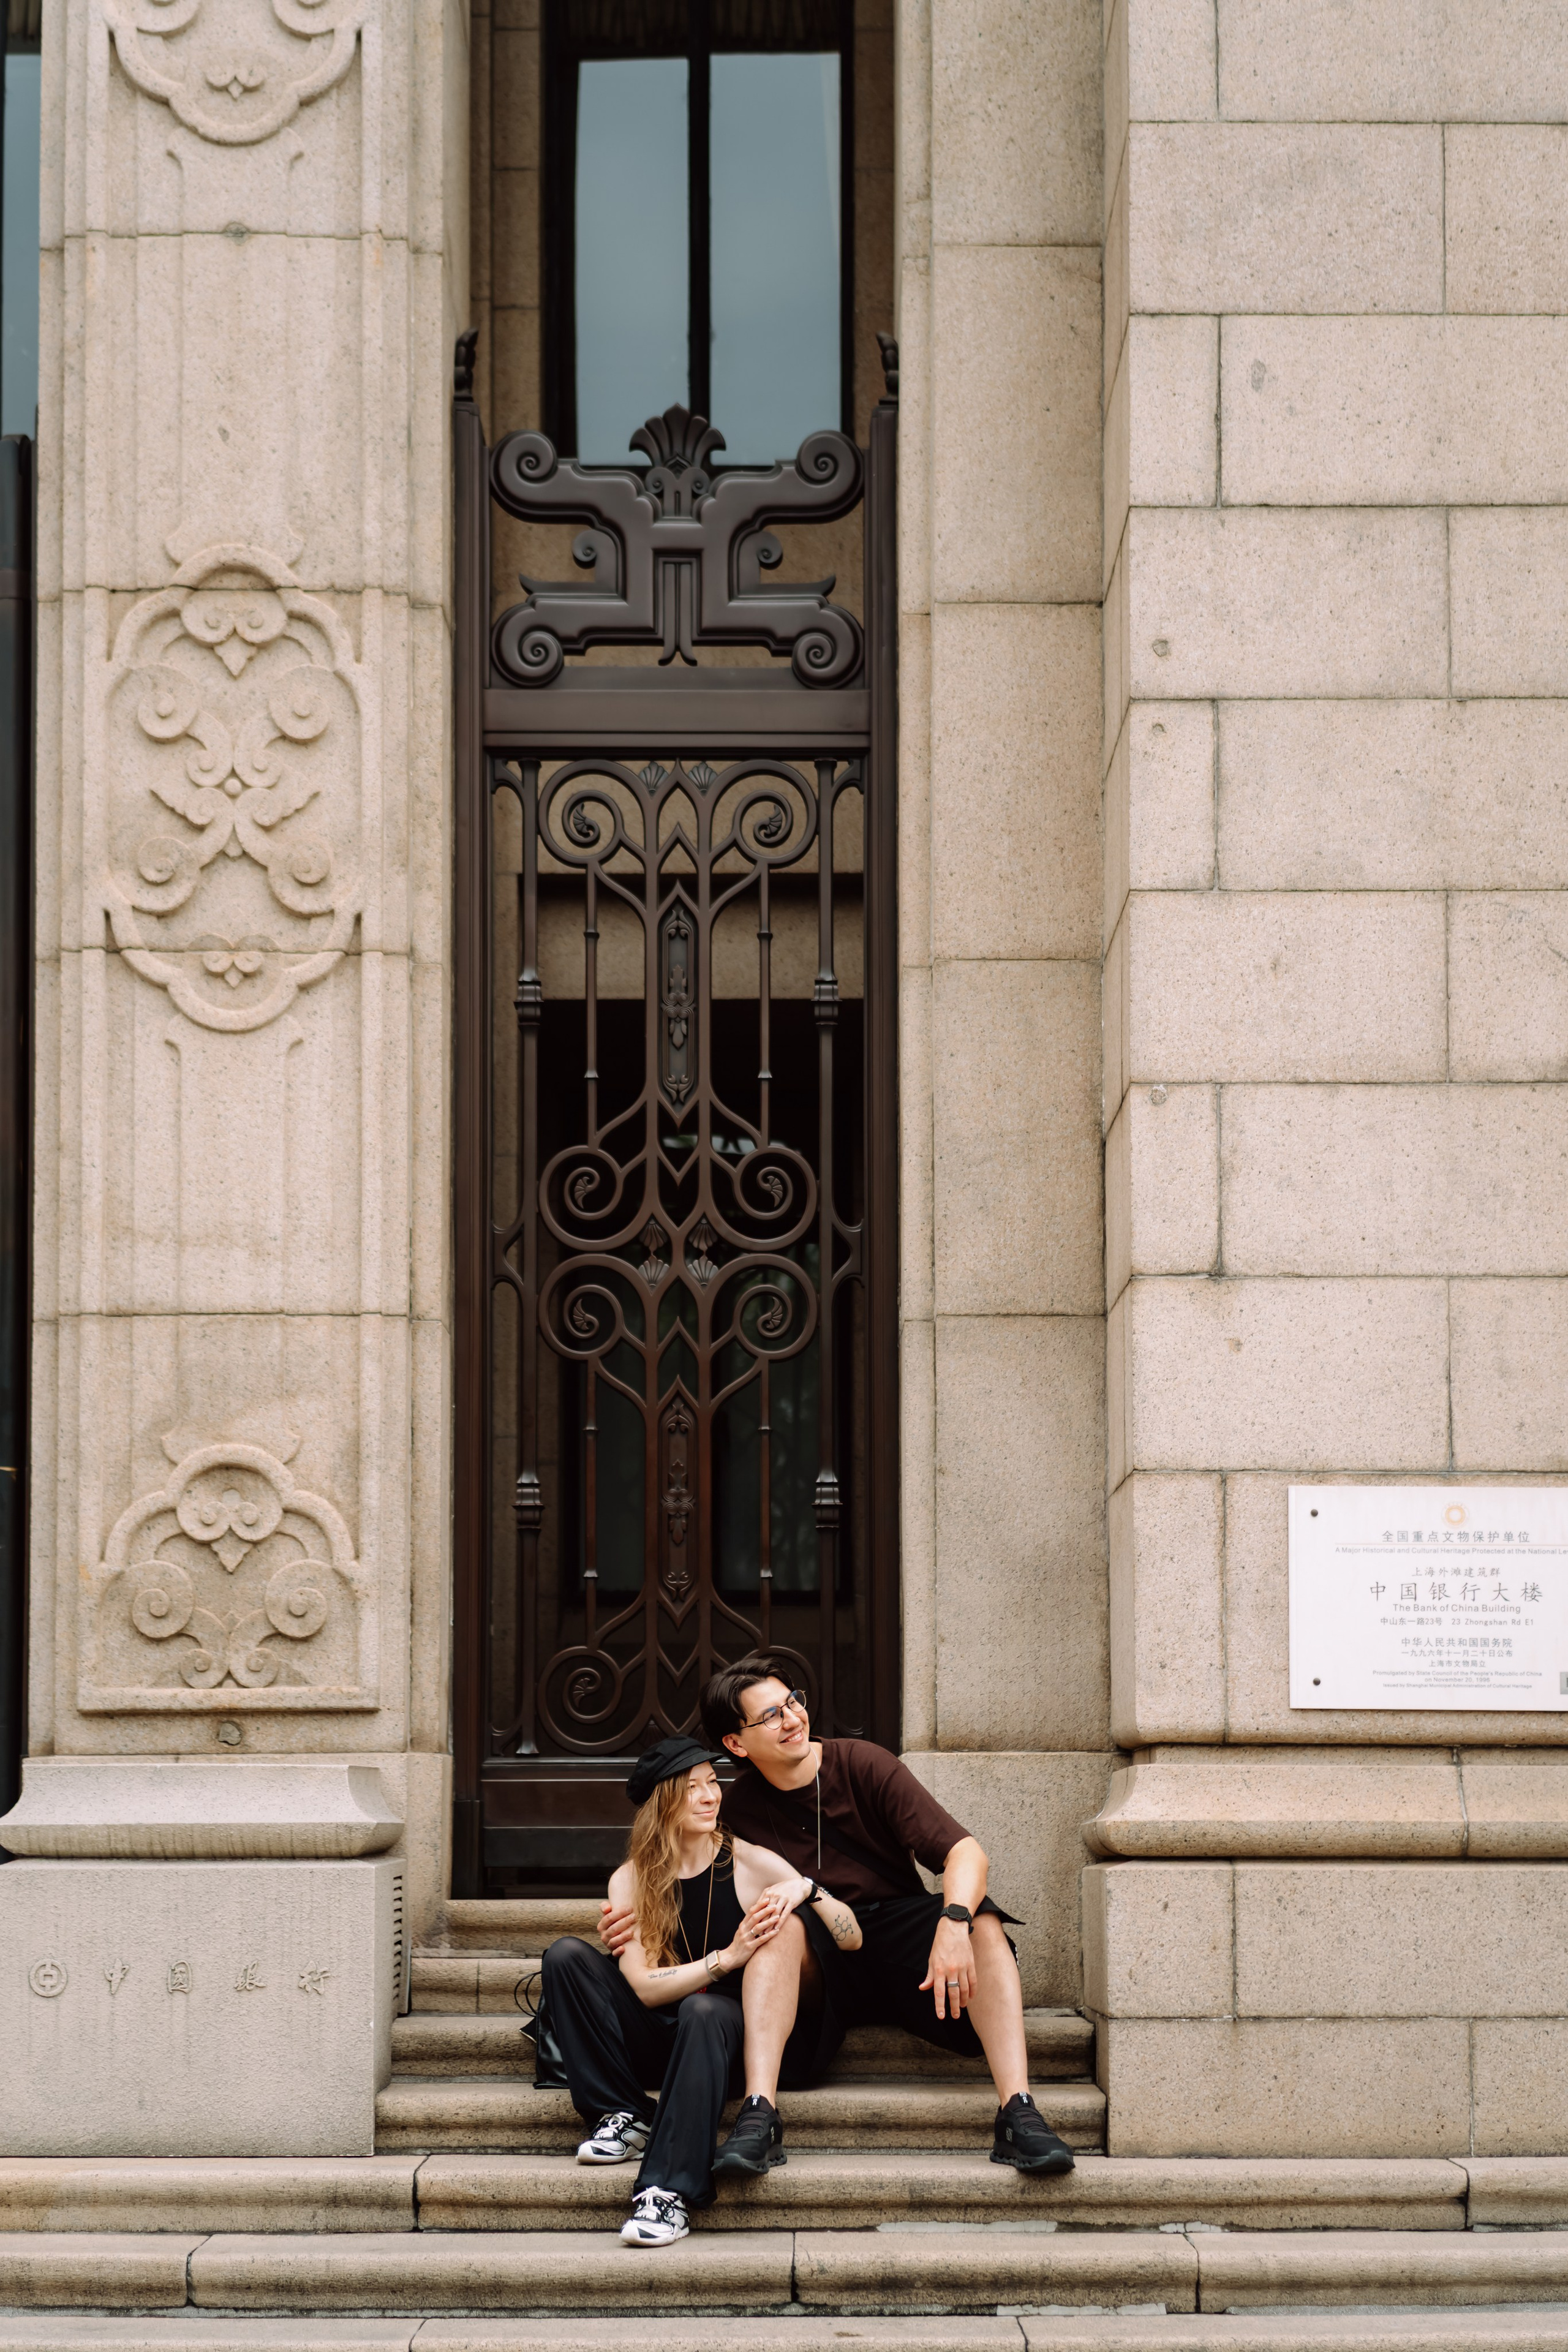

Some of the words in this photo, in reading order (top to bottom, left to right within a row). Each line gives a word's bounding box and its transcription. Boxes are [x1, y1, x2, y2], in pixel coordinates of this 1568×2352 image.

[1382, 1531, 1529, 1543] 全国重点文物保护单位
[1412, 1567, 1500, 1578] 上海外滩建筑群
[1370, 1581, 1542, 1602] 中国银行大楼
[1482, 1604, 1521, 1614] Building
[1381, 1617, 1442, 1626] 中山东一路23号
[1401, 1637, 1512, 1648] 中华人民共和国国务院
[1401, 1649, 1513, 1657] 一九九六年十一月二十日公布
